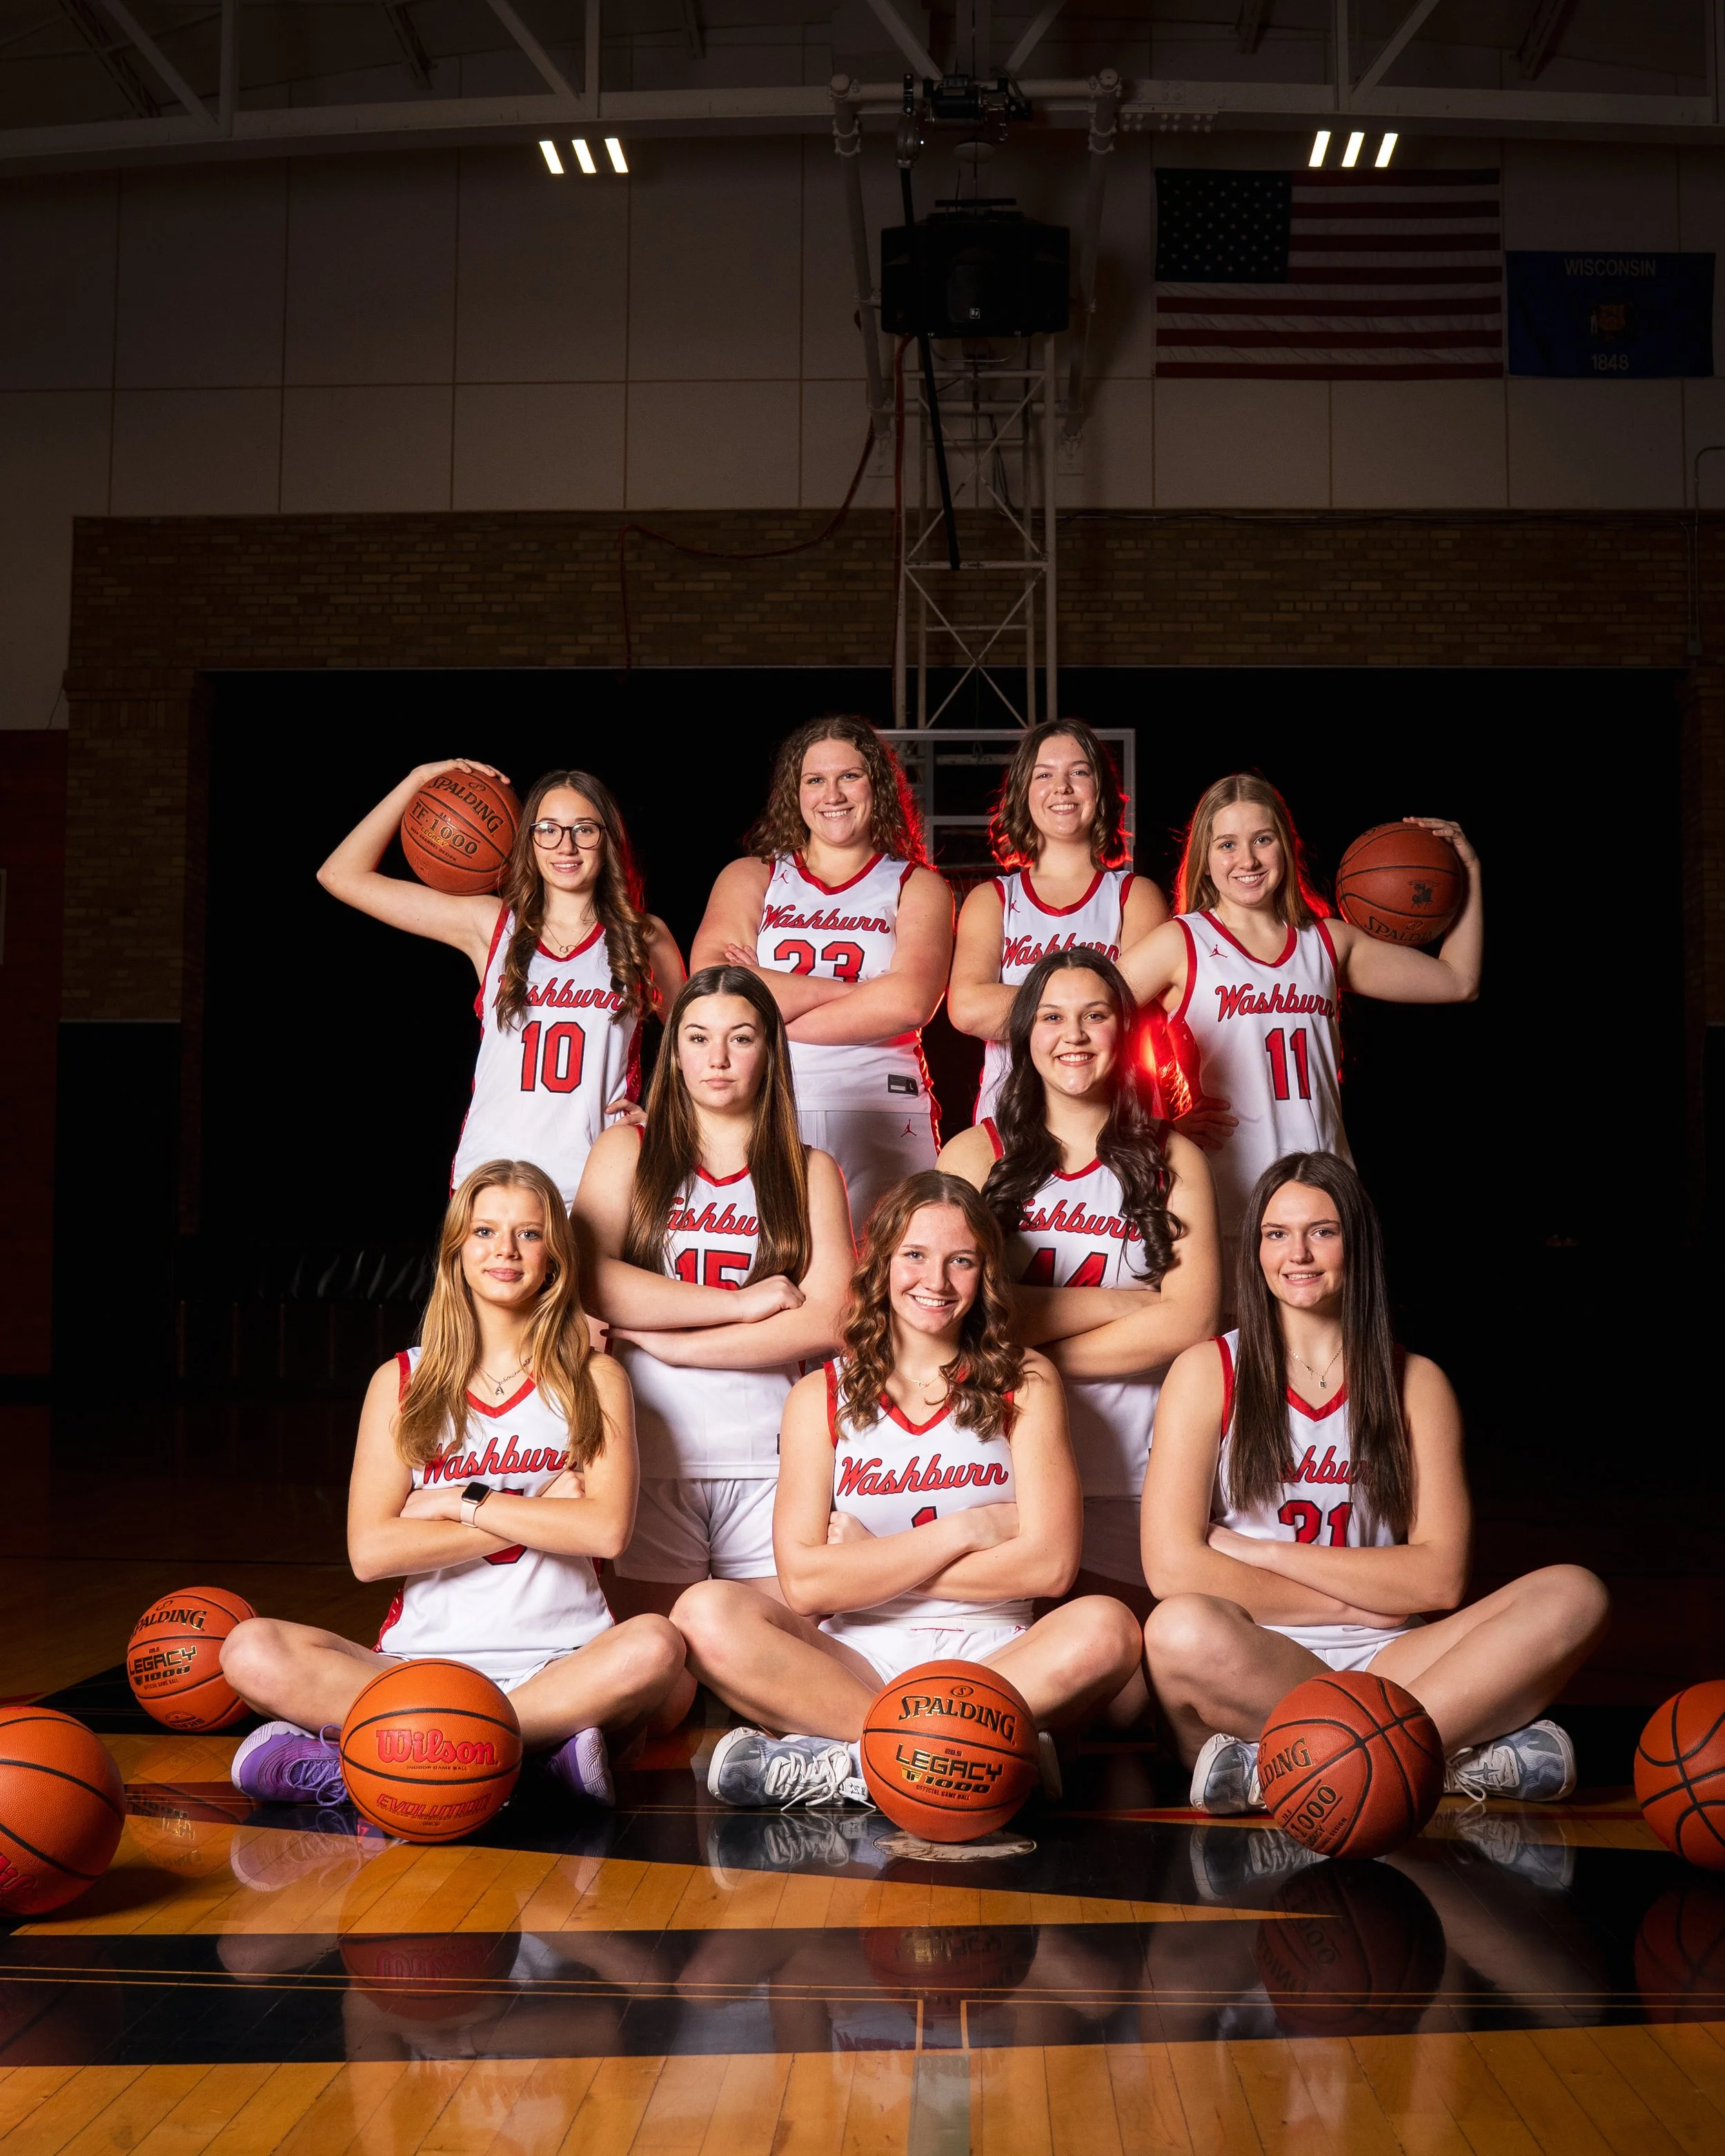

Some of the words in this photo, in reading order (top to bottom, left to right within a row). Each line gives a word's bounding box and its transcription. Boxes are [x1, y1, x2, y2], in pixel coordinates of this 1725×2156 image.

[1564, 258, 1656, 277] WISCONSIN
[1591, 353, 1629, 371] 1848
[428, 776, 504, 835] SPALDING
[420, 827, 448, 847] LEGACY
[759, 904, 891, 934] Washburn
[773, 939, 865, 983] 23
[492, 973, 624, 1011] shburn
[1214, 983, 1335, 1022] Washburn
[520, 1020, 586, 1094] 10
[1265, 1027, 1312, 1100] 11
[674, 1247, 752, 1291] 15
[836, 1453, 1009, 1497] Washburn
[1277, 1499, 1354, 1547] 21
[129, 1645, 197, 1676] LEGACY
[144, 1665, 190, 1683] 1000
[898, 1695, 1017, 1743] SPALDING
[376, 1729, 495, 1766] Wilson
[896, 1743, 1004, 1782] LEGACY
[945, 1748, 963, 1757] 28.5
[1259, 1736, 1312, 1794] LDING
[902, 1768, 923, 1783] TF
[924, 1774, 992, 1794] 1000
[916, 1784, 940, 1796] OFFICIAL
[940, 1791, 957, 1800] GAME
[957, 1792, 971, 1801] BALL
[376, 1793, 492, 1817] EVOLUTION
[1329, 1817, 1348, 1837] DESIGN
